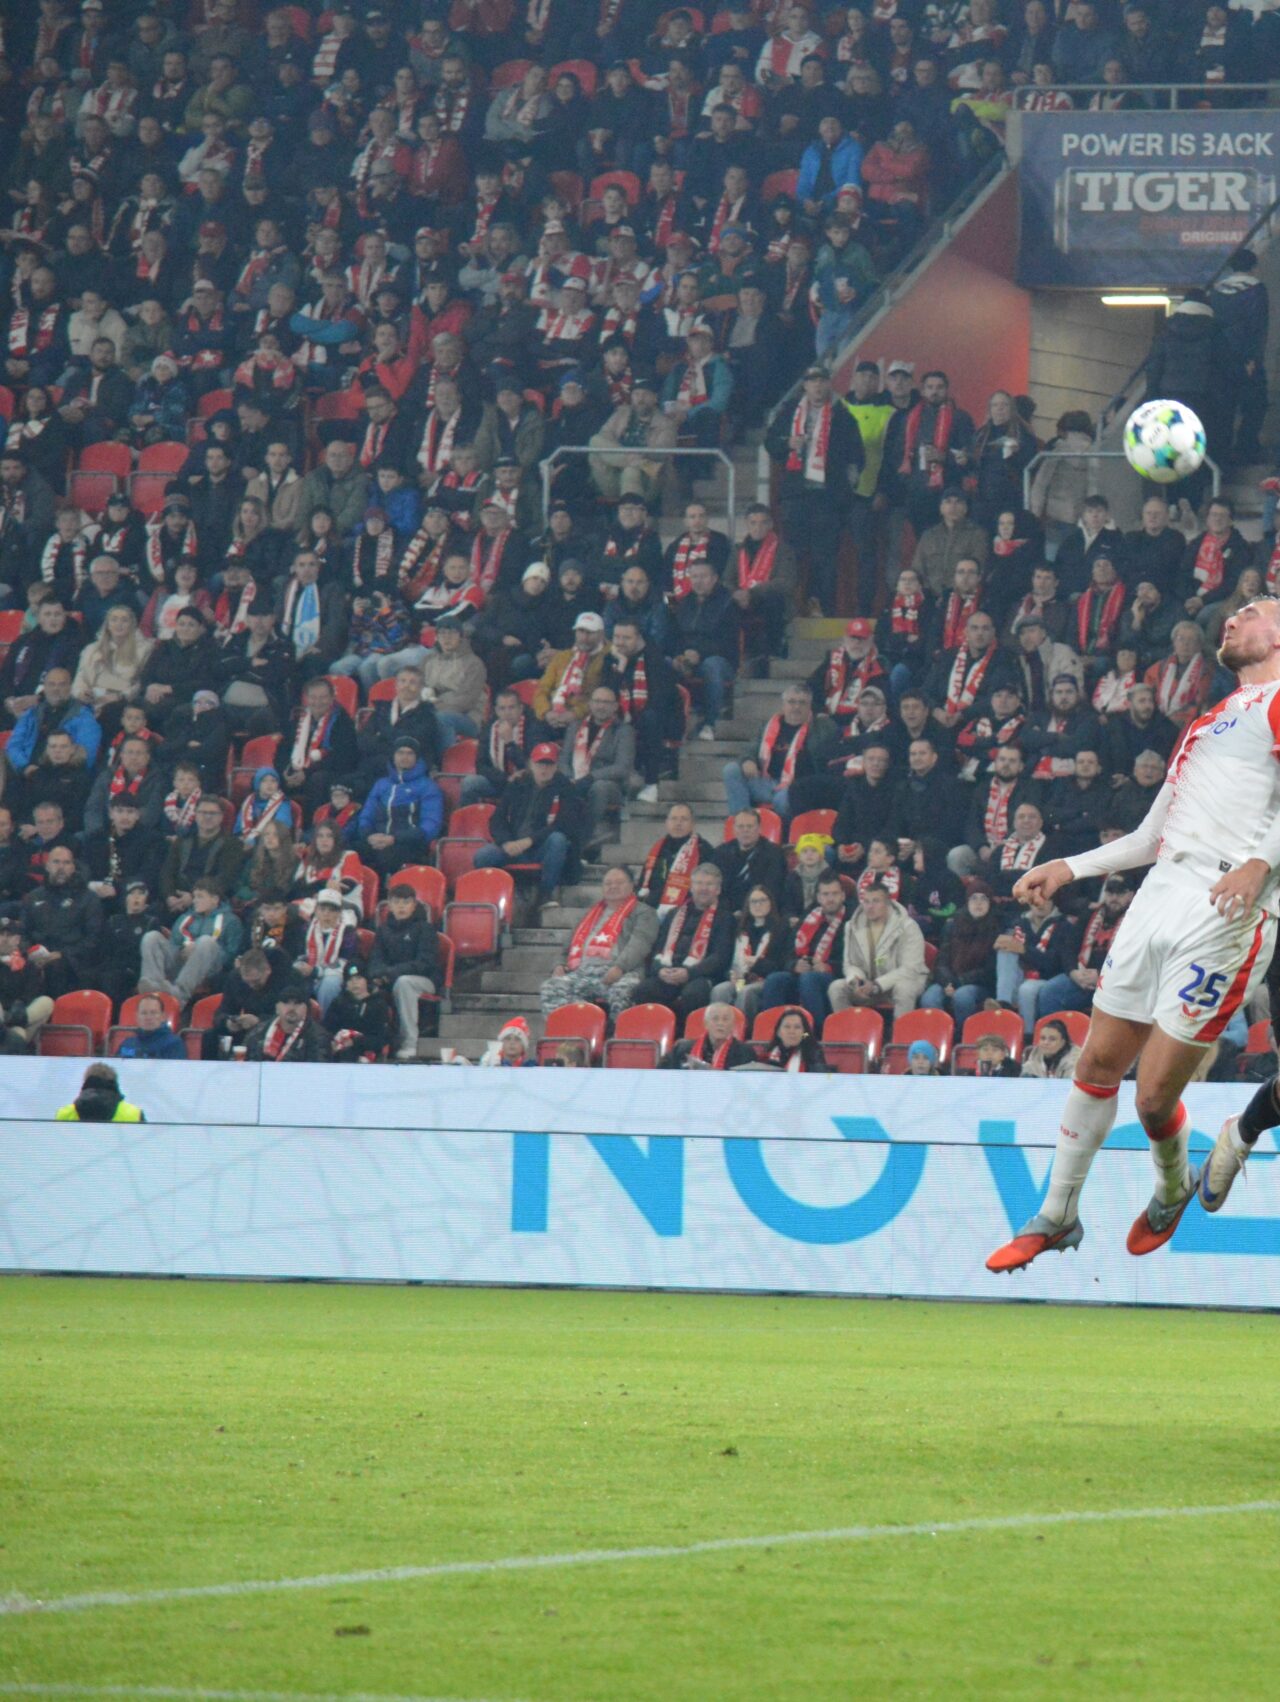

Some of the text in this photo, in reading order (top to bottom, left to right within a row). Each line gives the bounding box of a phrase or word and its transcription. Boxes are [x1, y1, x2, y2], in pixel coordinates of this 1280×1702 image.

[1062, 133, 1274, 156] POWER IS BACK
[1075, 172, 1251, 212] TIGER
[1181, 230, 1244, 243] ORIGINA
[1178, 962, 1228, 1008] 25
